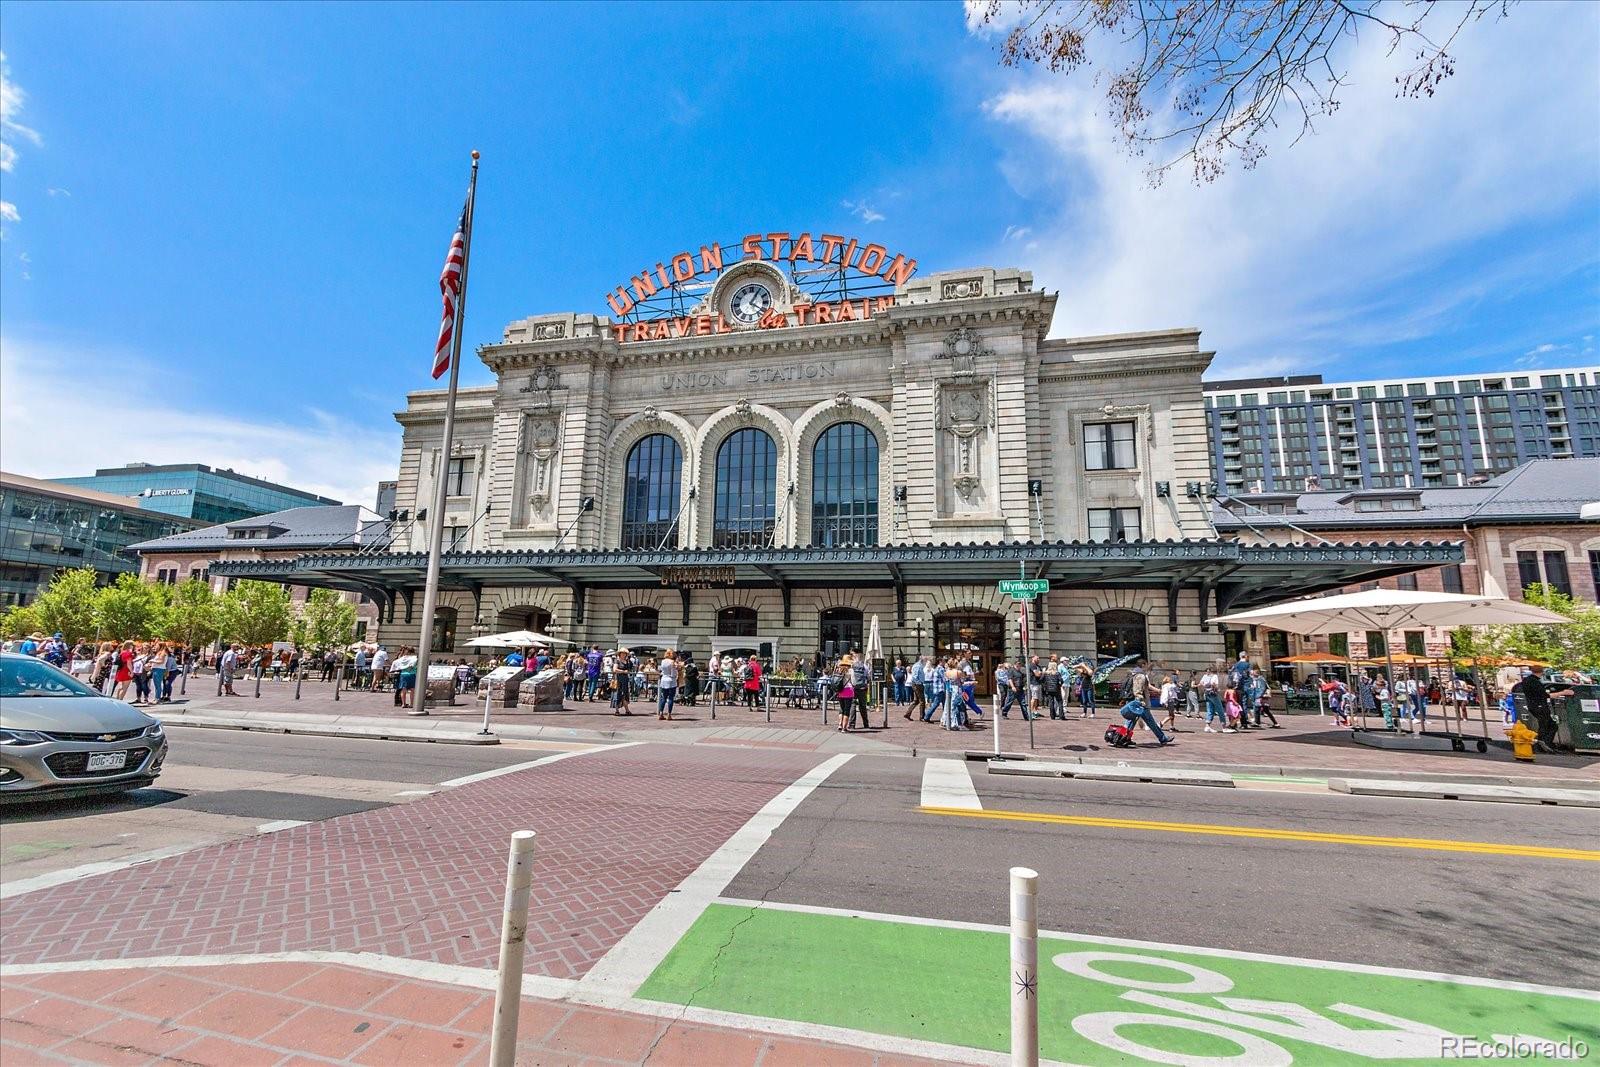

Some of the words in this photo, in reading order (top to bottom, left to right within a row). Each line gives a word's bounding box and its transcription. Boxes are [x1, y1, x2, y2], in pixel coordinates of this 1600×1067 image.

[606, 242, 723, 316] UNION
[742, 232, 917, 286] STATION
[613, 311, 732, 342] TRAVEL
[793, 296, 896, 326] TRAIN
[661, 371, 727, 390] UNION
[747, 361, 836, 383] STATION
[1002, 581, 1039, 591] Wynkoop
